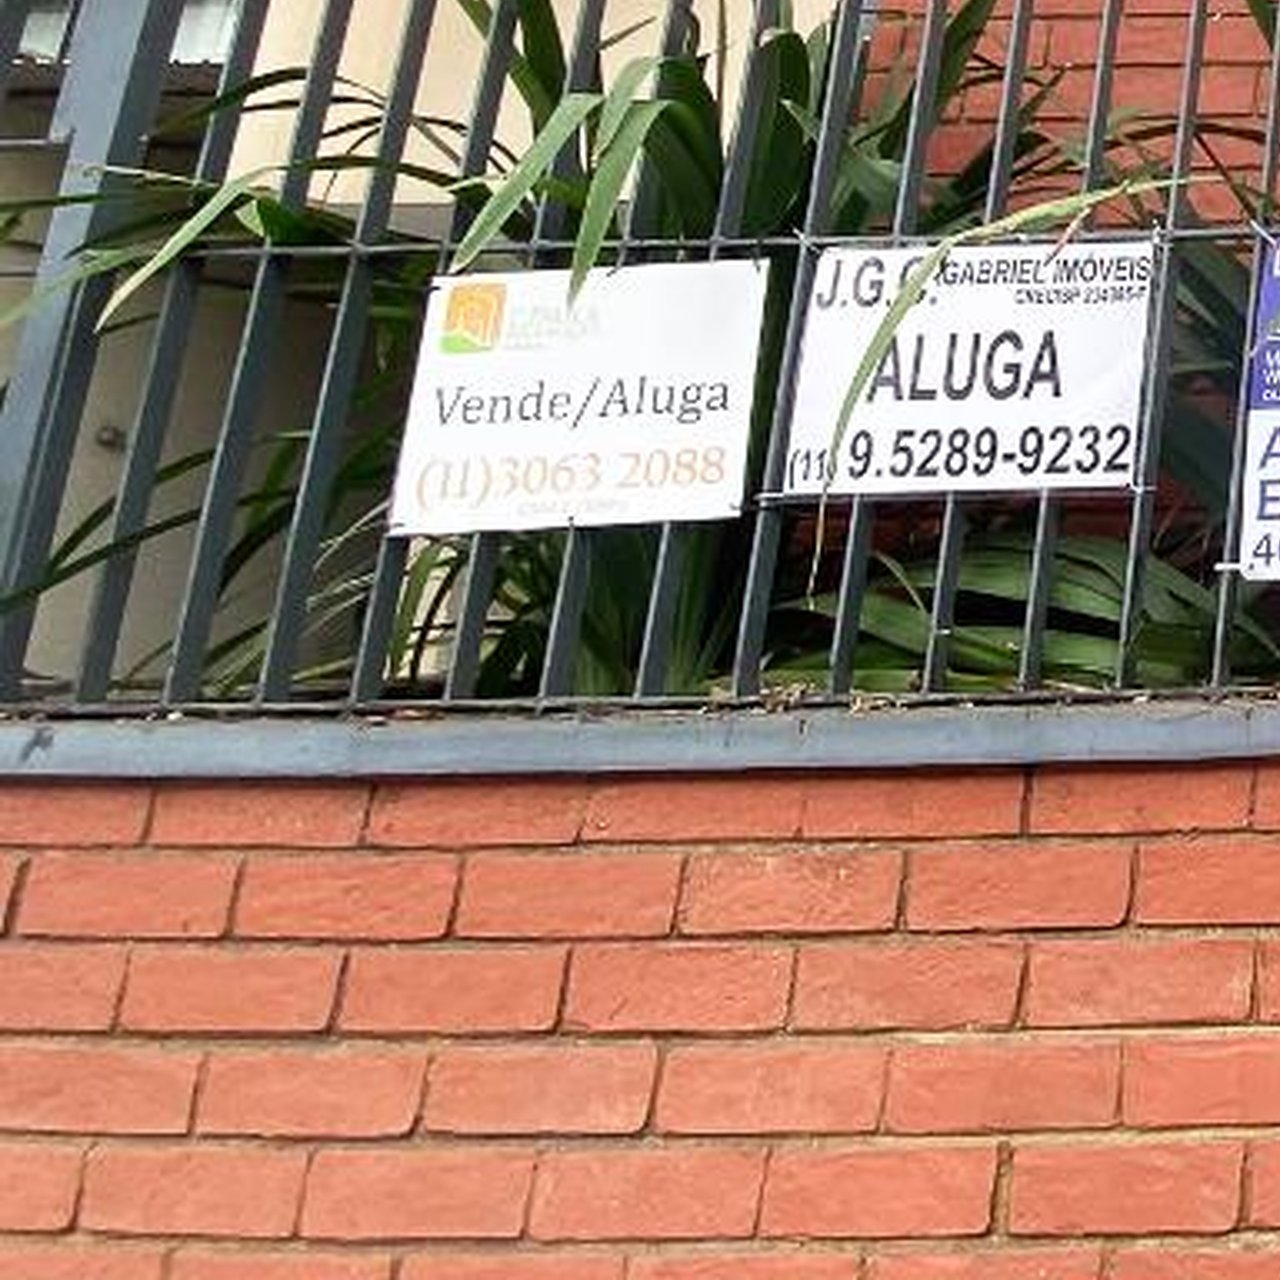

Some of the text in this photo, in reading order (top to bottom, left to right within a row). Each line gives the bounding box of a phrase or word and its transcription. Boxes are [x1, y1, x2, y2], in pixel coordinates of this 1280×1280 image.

[942, 258, 1046, 286] GABRIEL
[1053, 253, 1153, 284] IMÓVEIS
[866, 329, 1062, 403] ALUGA
[435, 375, 730, 428] Vende/Aluga
[416, 444, 727, 509] (11)3063 2088
[847, 423, 1132, 478] 9.5289-9232
